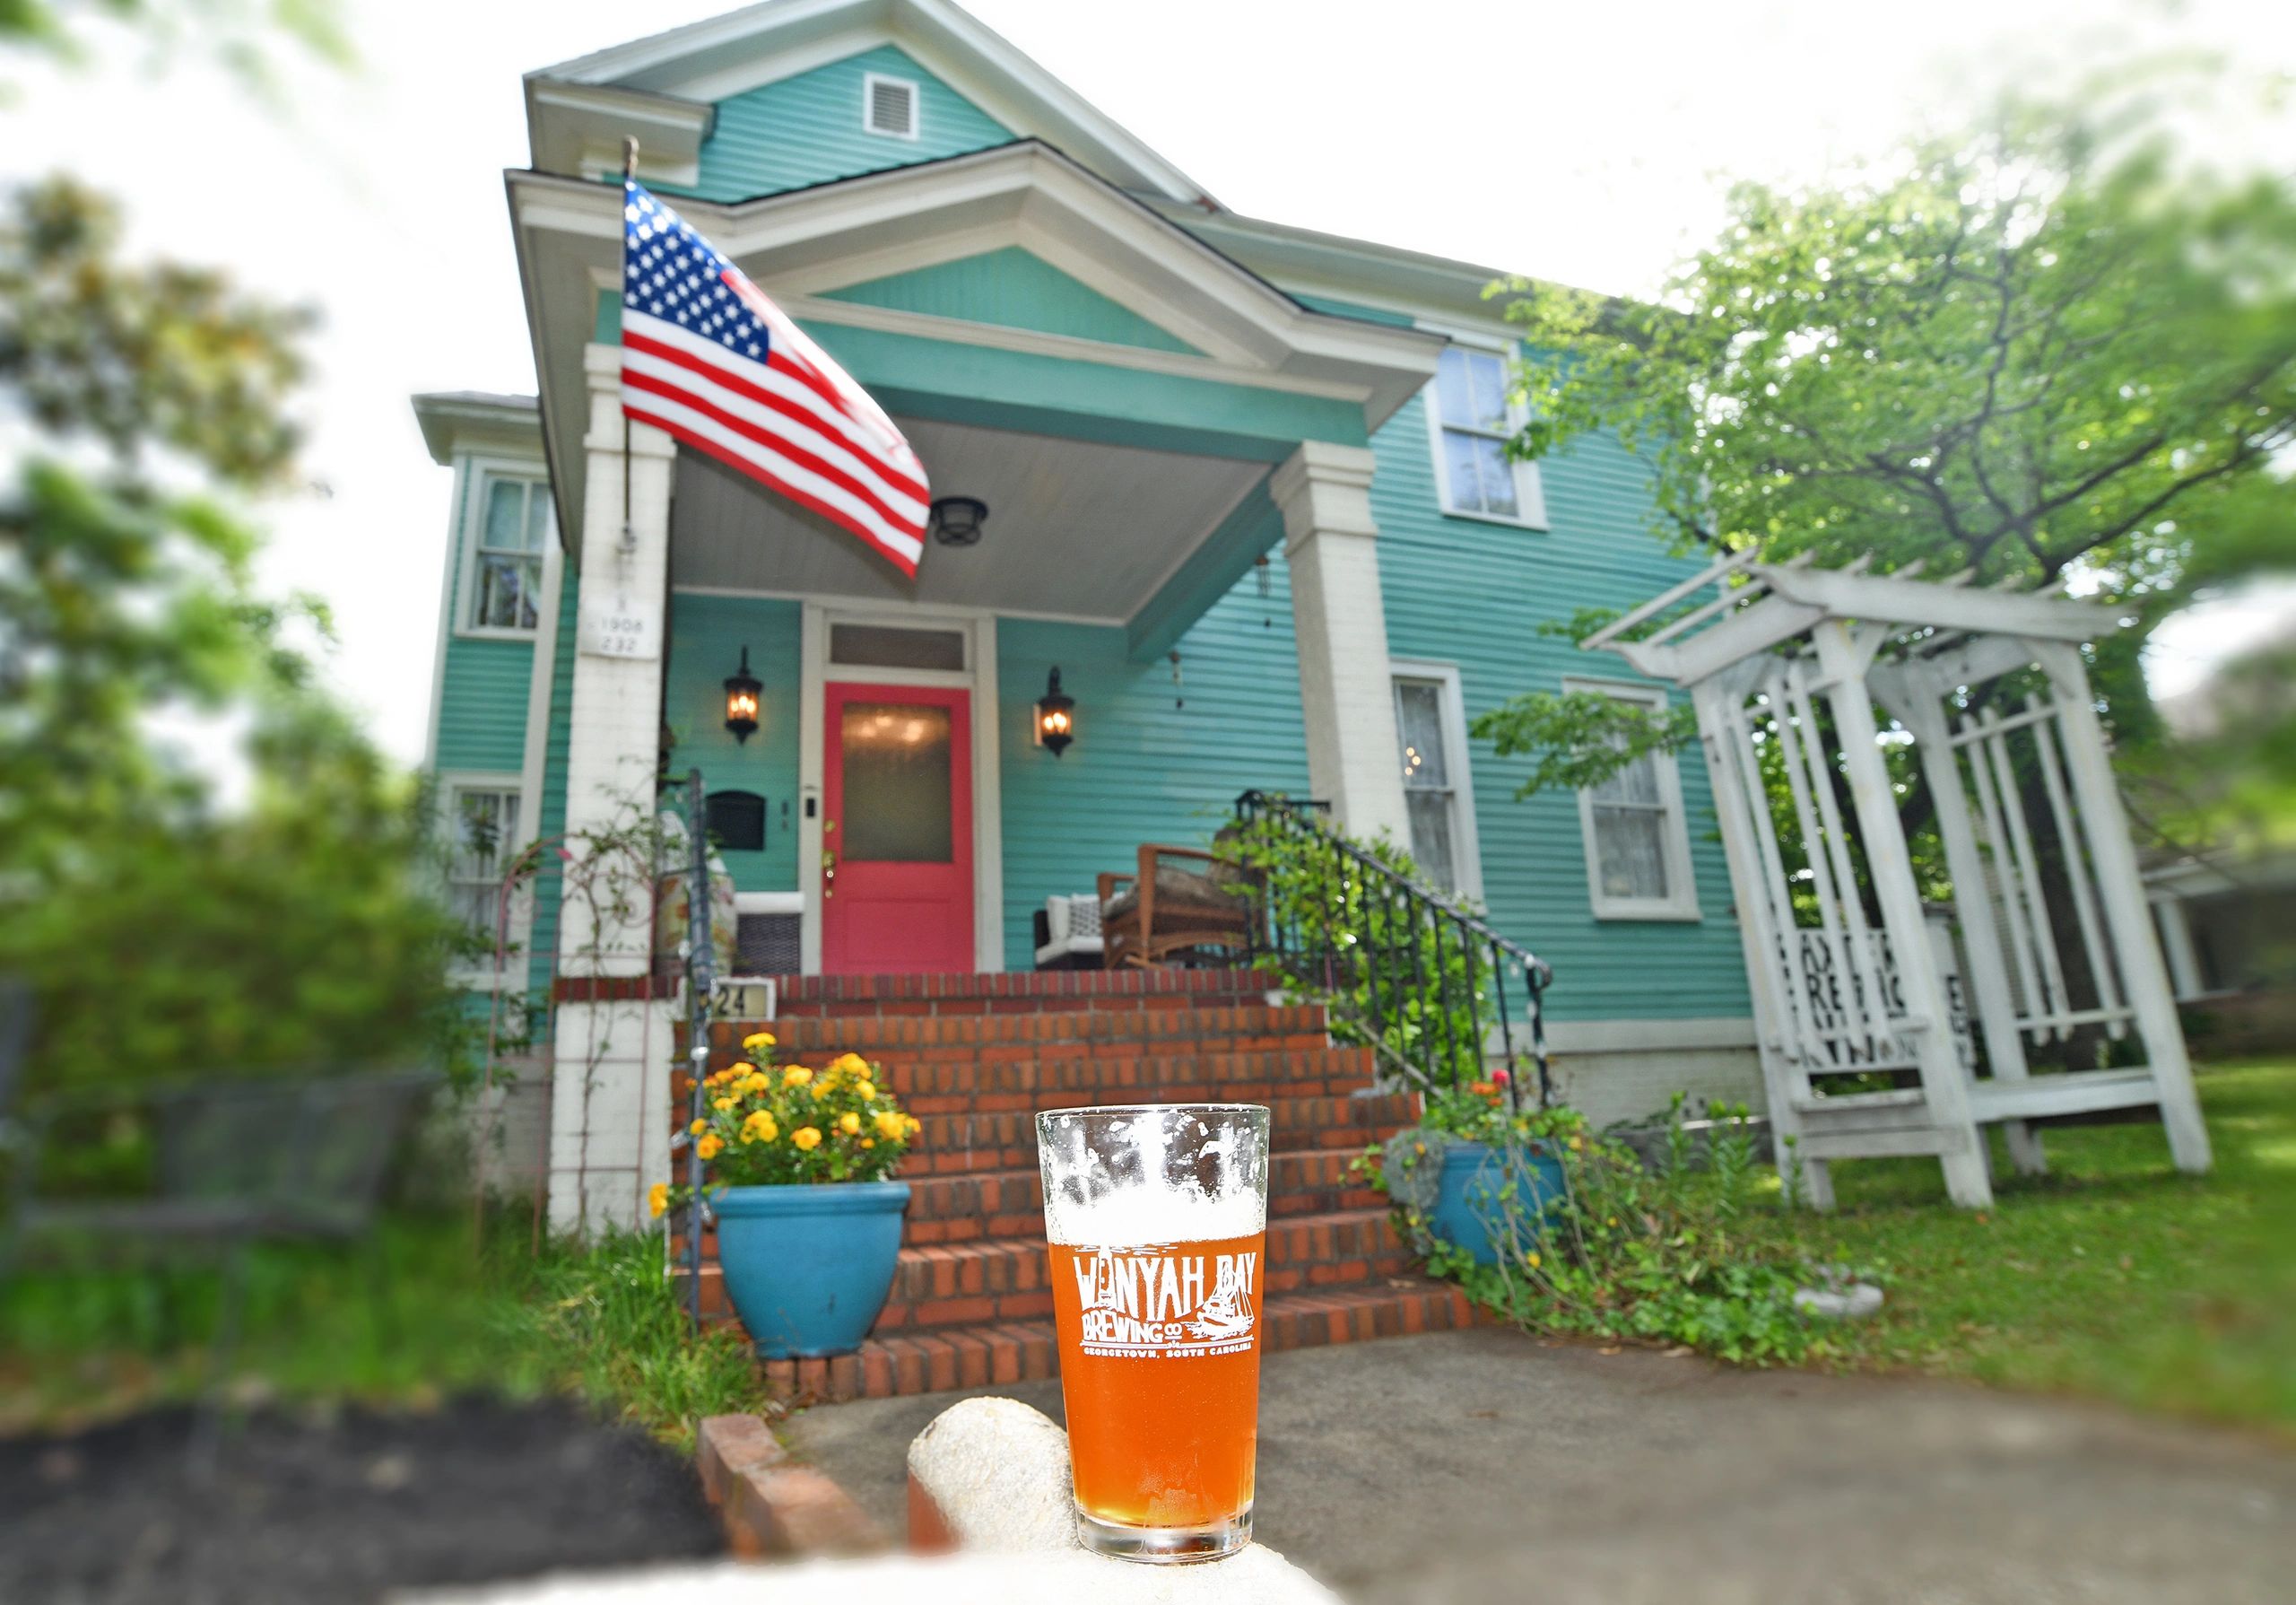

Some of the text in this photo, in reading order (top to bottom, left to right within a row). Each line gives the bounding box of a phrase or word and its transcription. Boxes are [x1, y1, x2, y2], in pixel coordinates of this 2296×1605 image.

[1082, 1307, 1164, 1343] BREWING
[1083, 1342, 1252, 1359] GEORGETOWN, SOUTH CAROLINA
